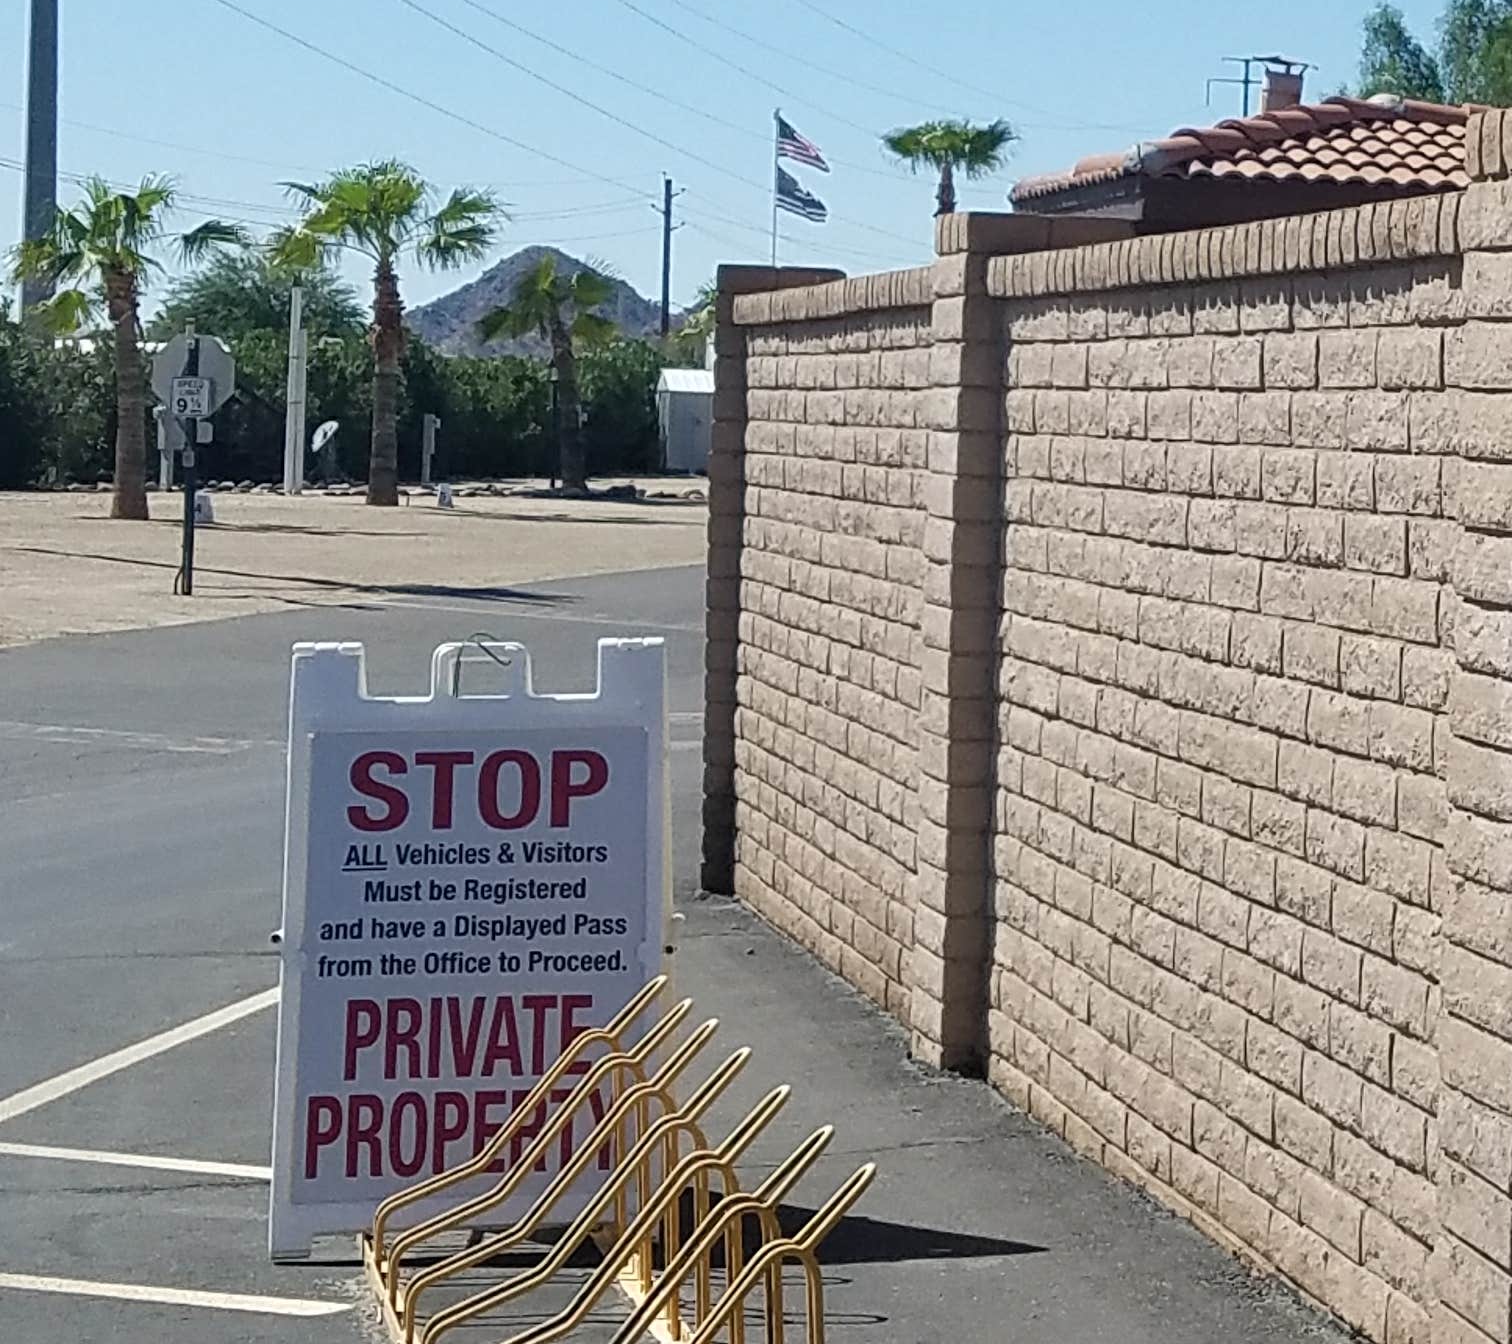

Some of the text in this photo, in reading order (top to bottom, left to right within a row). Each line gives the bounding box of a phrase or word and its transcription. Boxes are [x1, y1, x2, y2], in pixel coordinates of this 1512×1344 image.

[177, 398, 187, 413] 9
[346, 748, 610, 833] STOP
[343, 841, 608, 868] ALL Vehicles & Visitors
[363, 877, 587, 905] Must be Registered
[320, 914, 628, 944] and have a Displayed Pass
[318, 949, 629, 978] from the Office to Proceed.
[343, 994, 594, 1081] PRIVATE
[304, 1089, 617, 1179] PROPERTY
